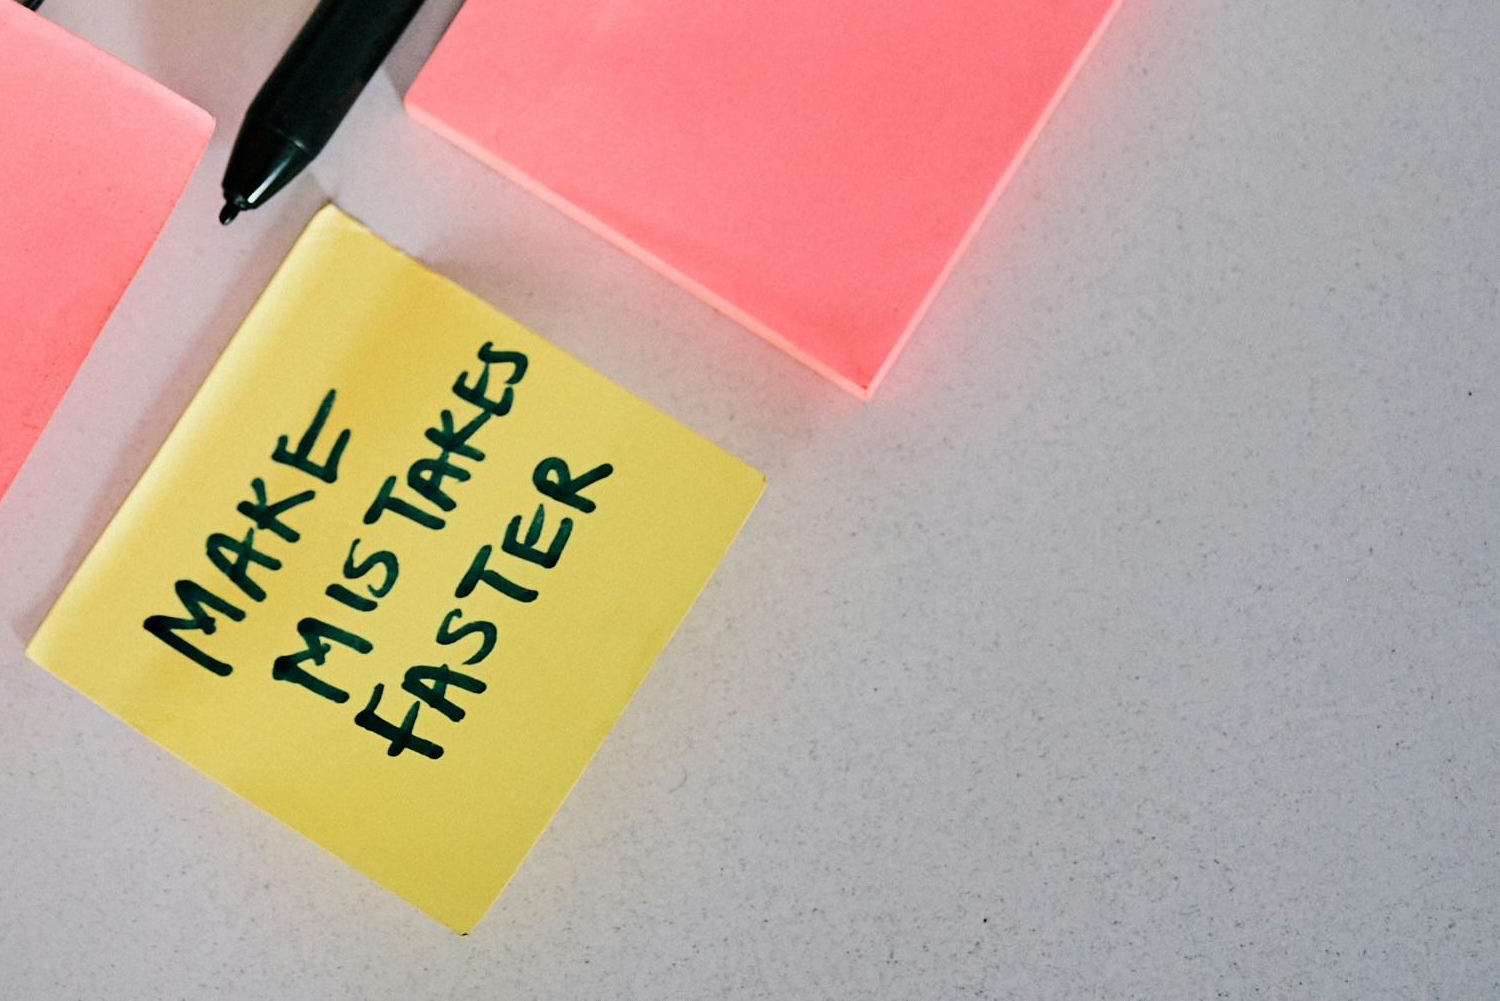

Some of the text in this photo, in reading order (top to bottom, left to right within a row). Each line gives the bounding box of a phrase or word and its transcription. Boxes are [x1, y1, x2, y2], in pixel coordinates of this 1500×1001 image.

[142, 388, 352, 677] MAKE
[271, 340, 530, 704] MISTAKES
[353, 455, 614, 760] FASTER
